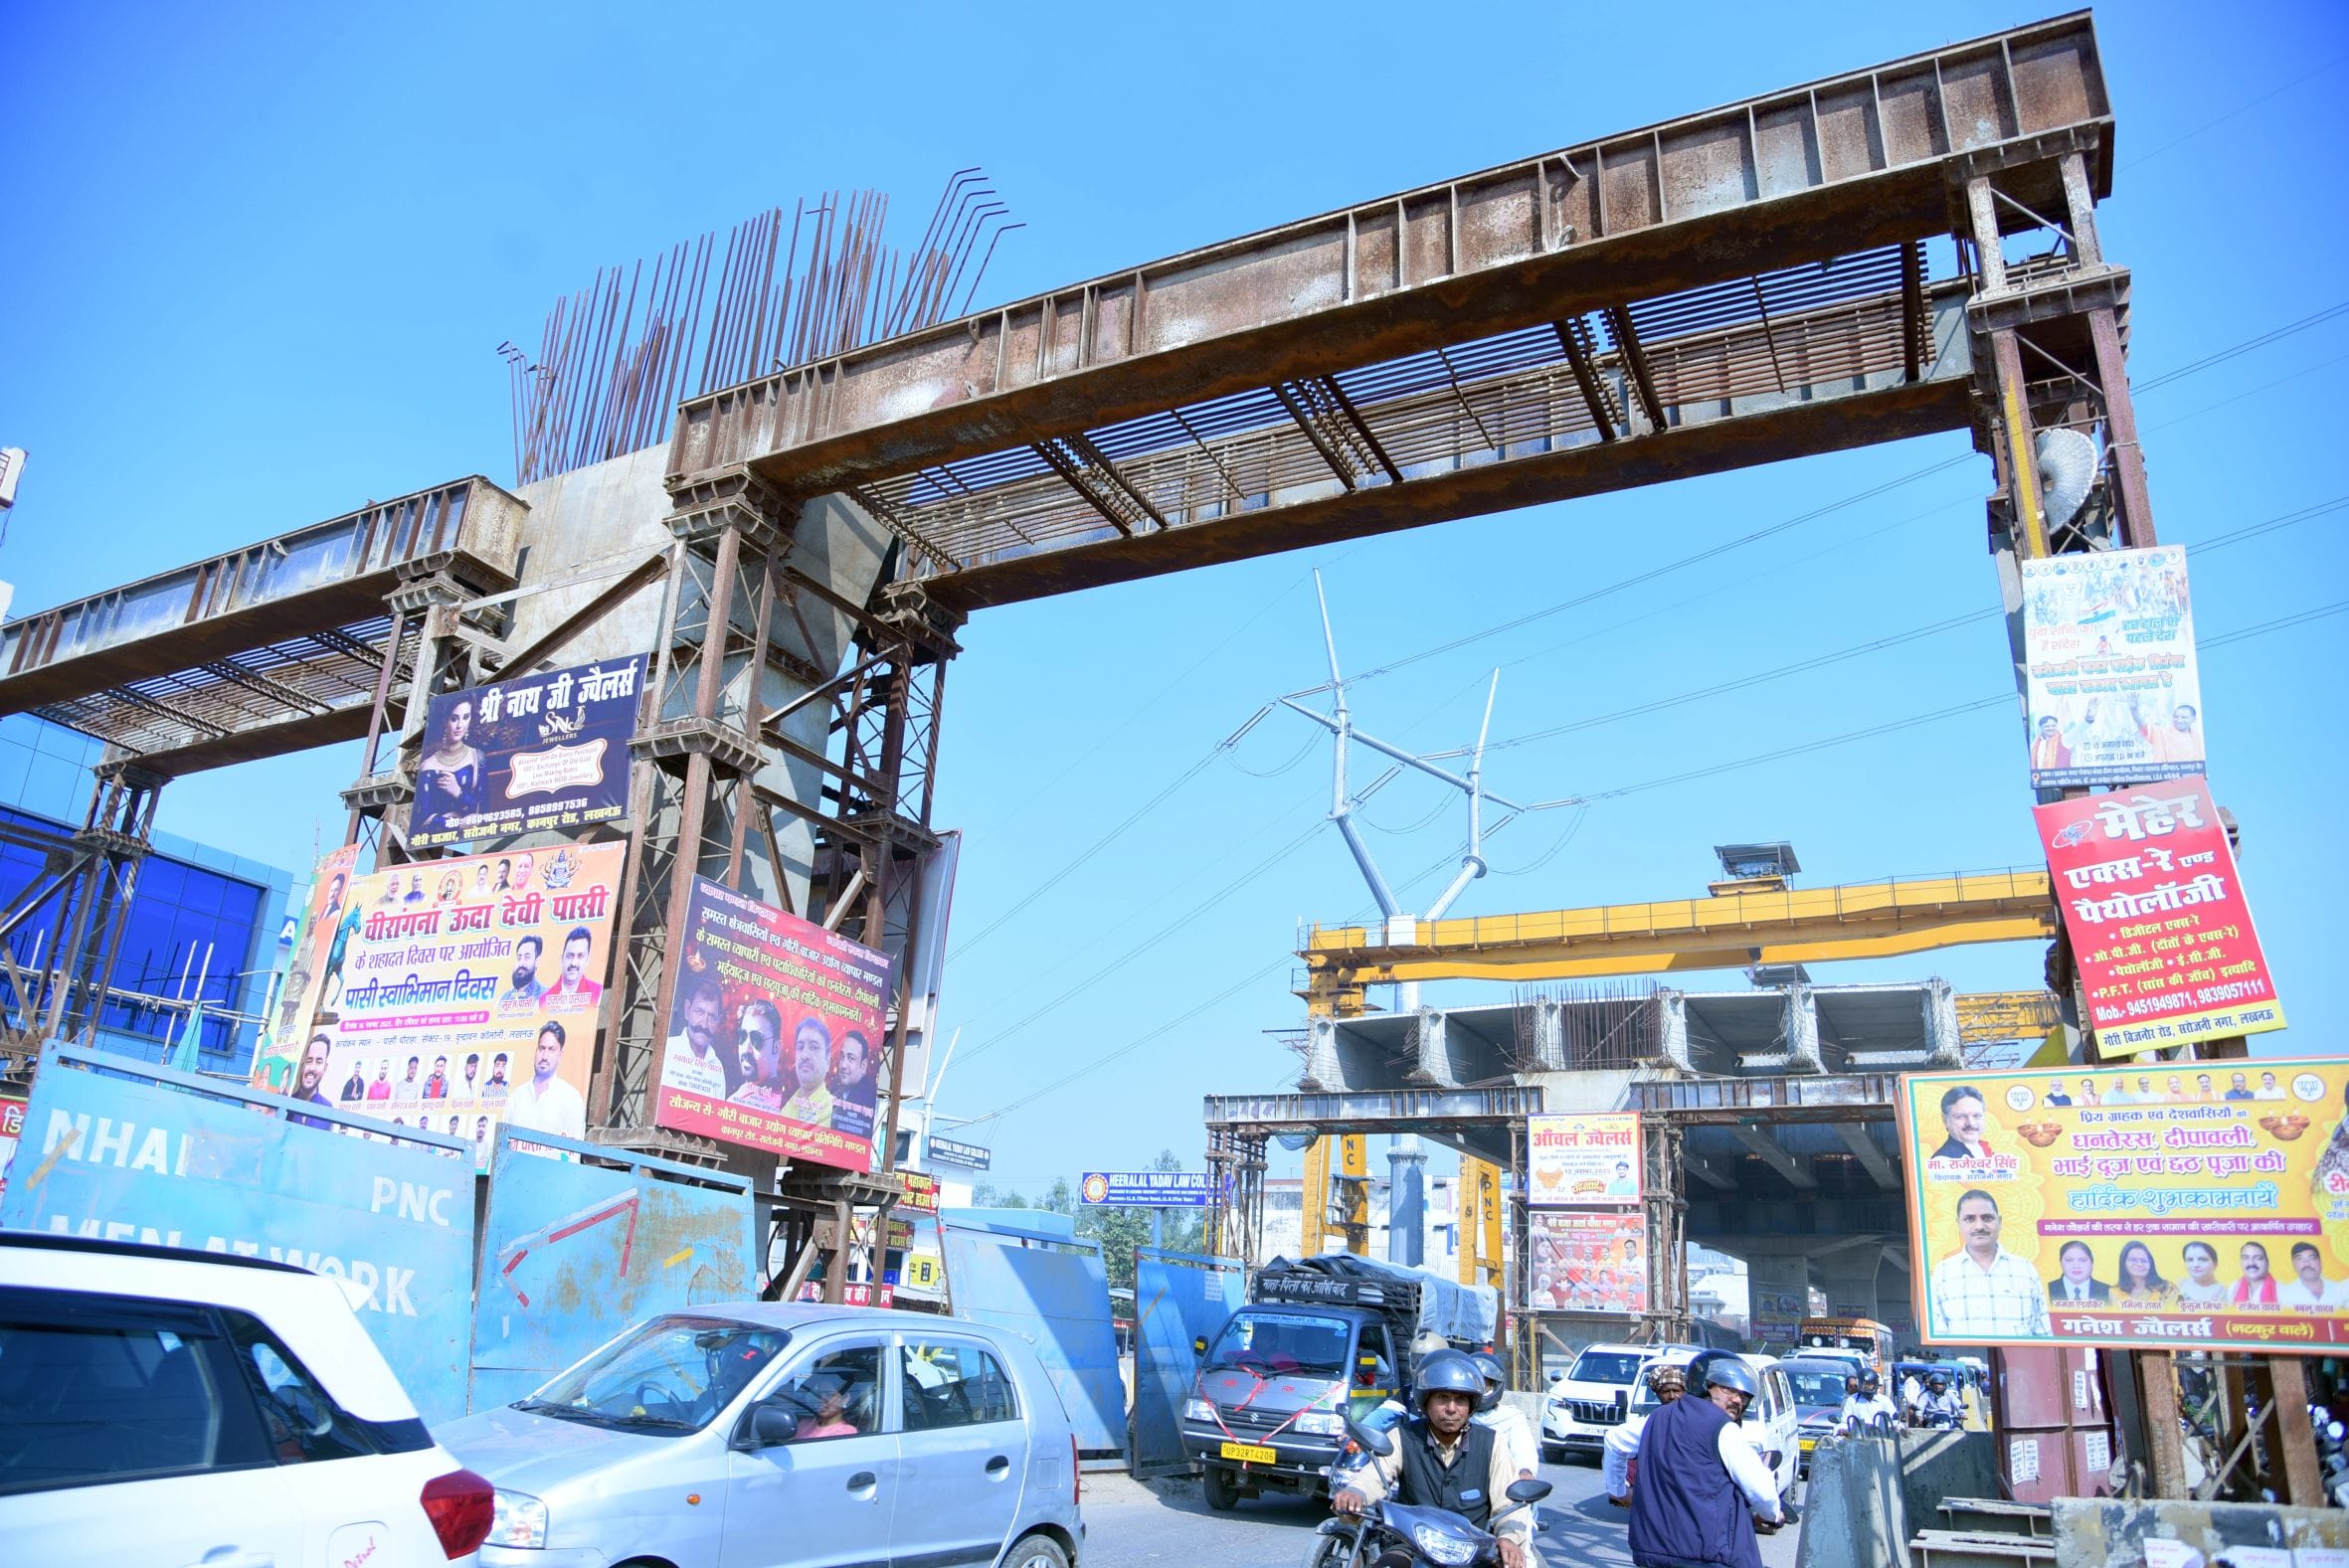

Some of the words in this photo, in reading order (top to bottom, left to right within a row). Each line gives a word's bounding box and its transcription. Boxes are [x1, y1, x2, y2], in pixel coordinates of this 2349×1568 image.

[479, 687, 503, 725] श्री
[546, 672, 574, 710] जी
[542, 733, 578, 744] JEWELLERS
[449, 903, 495, 933] ऊदा
[500, 892, 545, 926] देवी
[552, 885, 611, 921] पासी
[702, 906, 727, 927] समस्त
[706, 934, 731, 953] समस्त
[2183, 934, 2195, 946] के
[355, 950, 368, 970] के
[406, 941, 436, 966] दिवस
[439, 946, 456, 961] पर
[460, 937, 512, 960] आयोजित
[452, 968, 499, 1001] दिवस
[2168, 971, 2184, 986] की
[2198, 978, 2265, 1004] 9839057111
[2080, 1109, 2103, 1124] प्रिय
[2147, 1108, 2164, 1121] एवं
[41, 1108, 189, 1178] NHAI
[1994, 1154, 2018, 1169] सिंह
[2054, 1153, 2092, 1177] भाई
[2096, 1156, 2132, 1179] दूज
[2135, 1151, 2163, 1173] एवं
[2206, 1153, 2250, 1177] पूजा
[2254, 1149, 2285, 1171] की
[1109, 1174, 1148, 1188] HEERALAL
[1149, 1174, 1173, 1188] YADAV
[1174, 1175, 1190, 1188] LAW
[371, 1176, 452, 1227] PNC
[2061, 1315, 2123, 1336] गनेश
